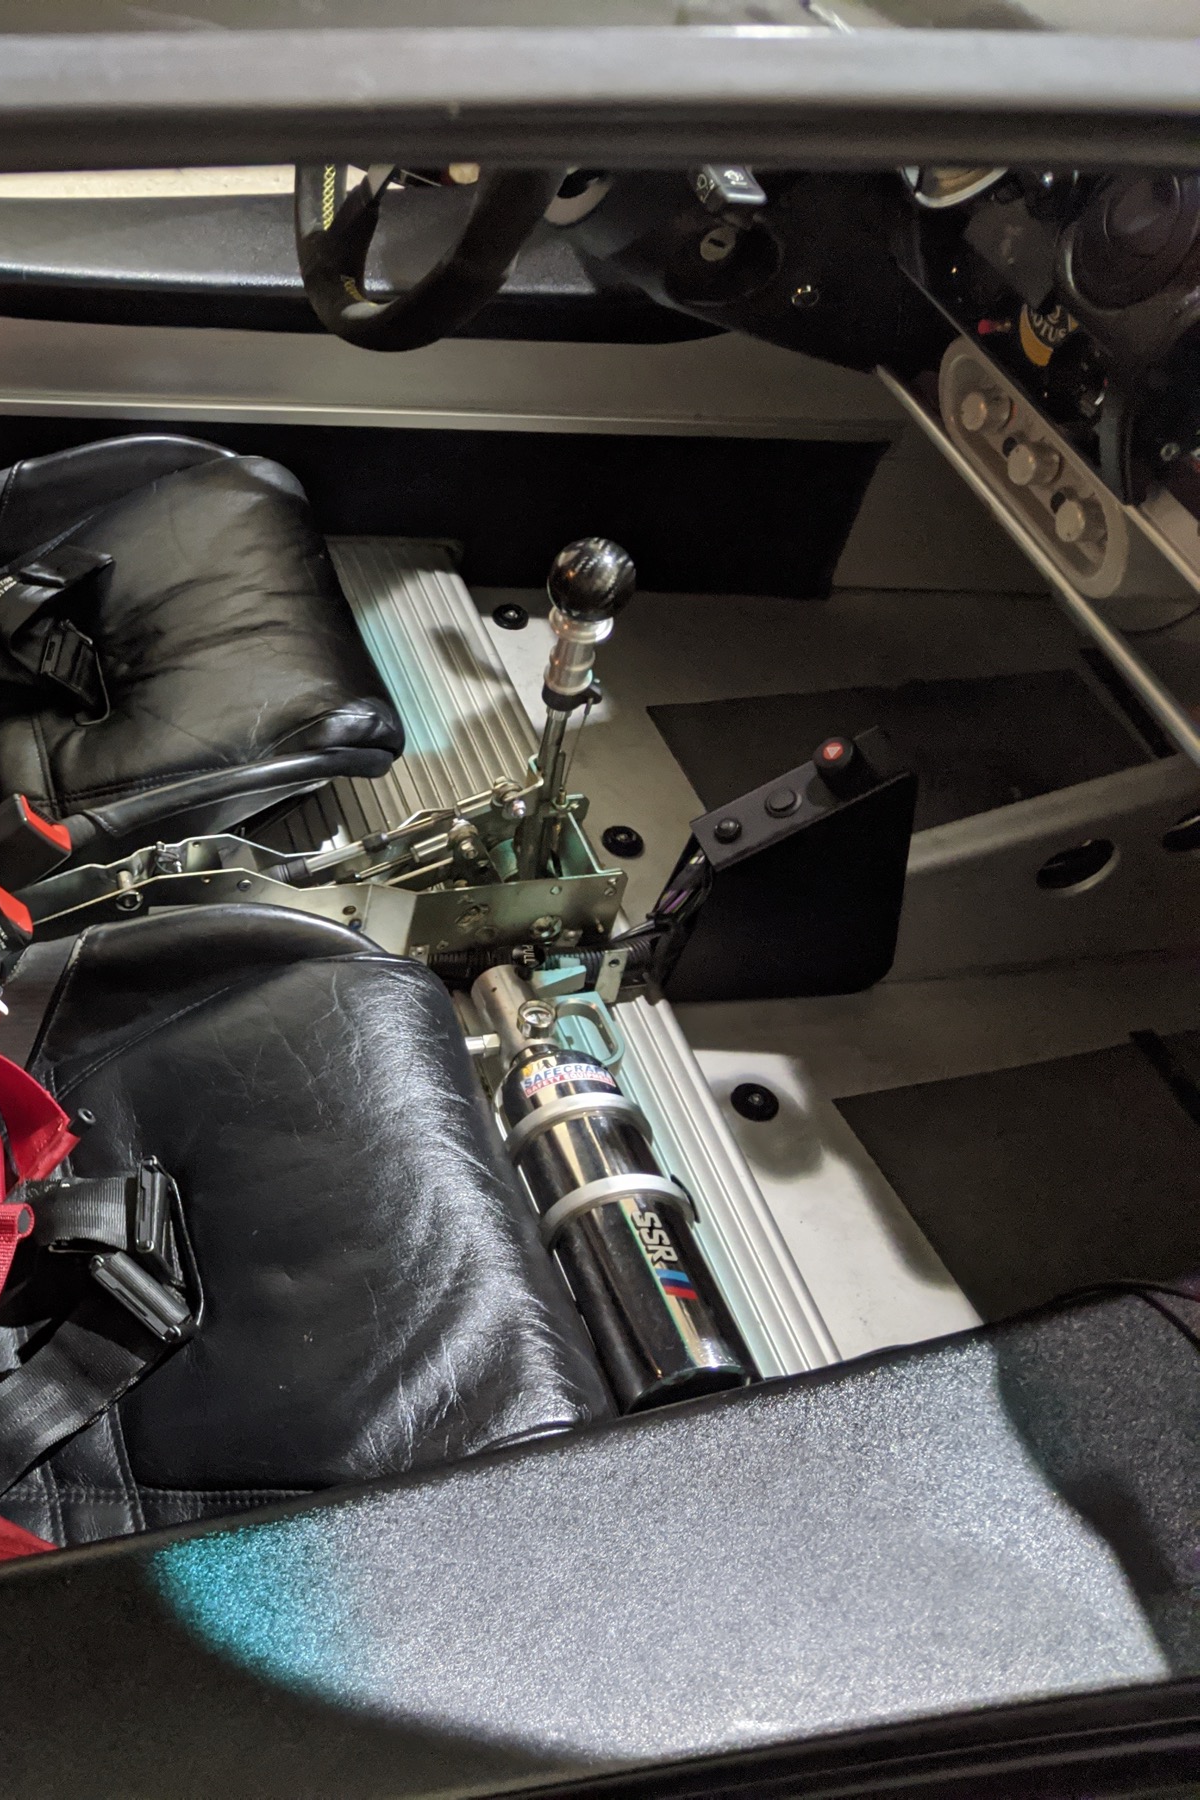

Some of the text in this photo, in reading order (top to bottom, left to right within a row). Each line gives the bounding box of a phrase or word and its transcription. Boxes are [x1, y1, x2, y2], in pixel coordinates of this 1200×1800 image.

[1030, 307, 1068, 342] OTUS
[522, 944, 537, 965] PULL
[523, 1064, 610, 1089] SAFECRAFT
[630, 1211, 679, 1263] SSR
